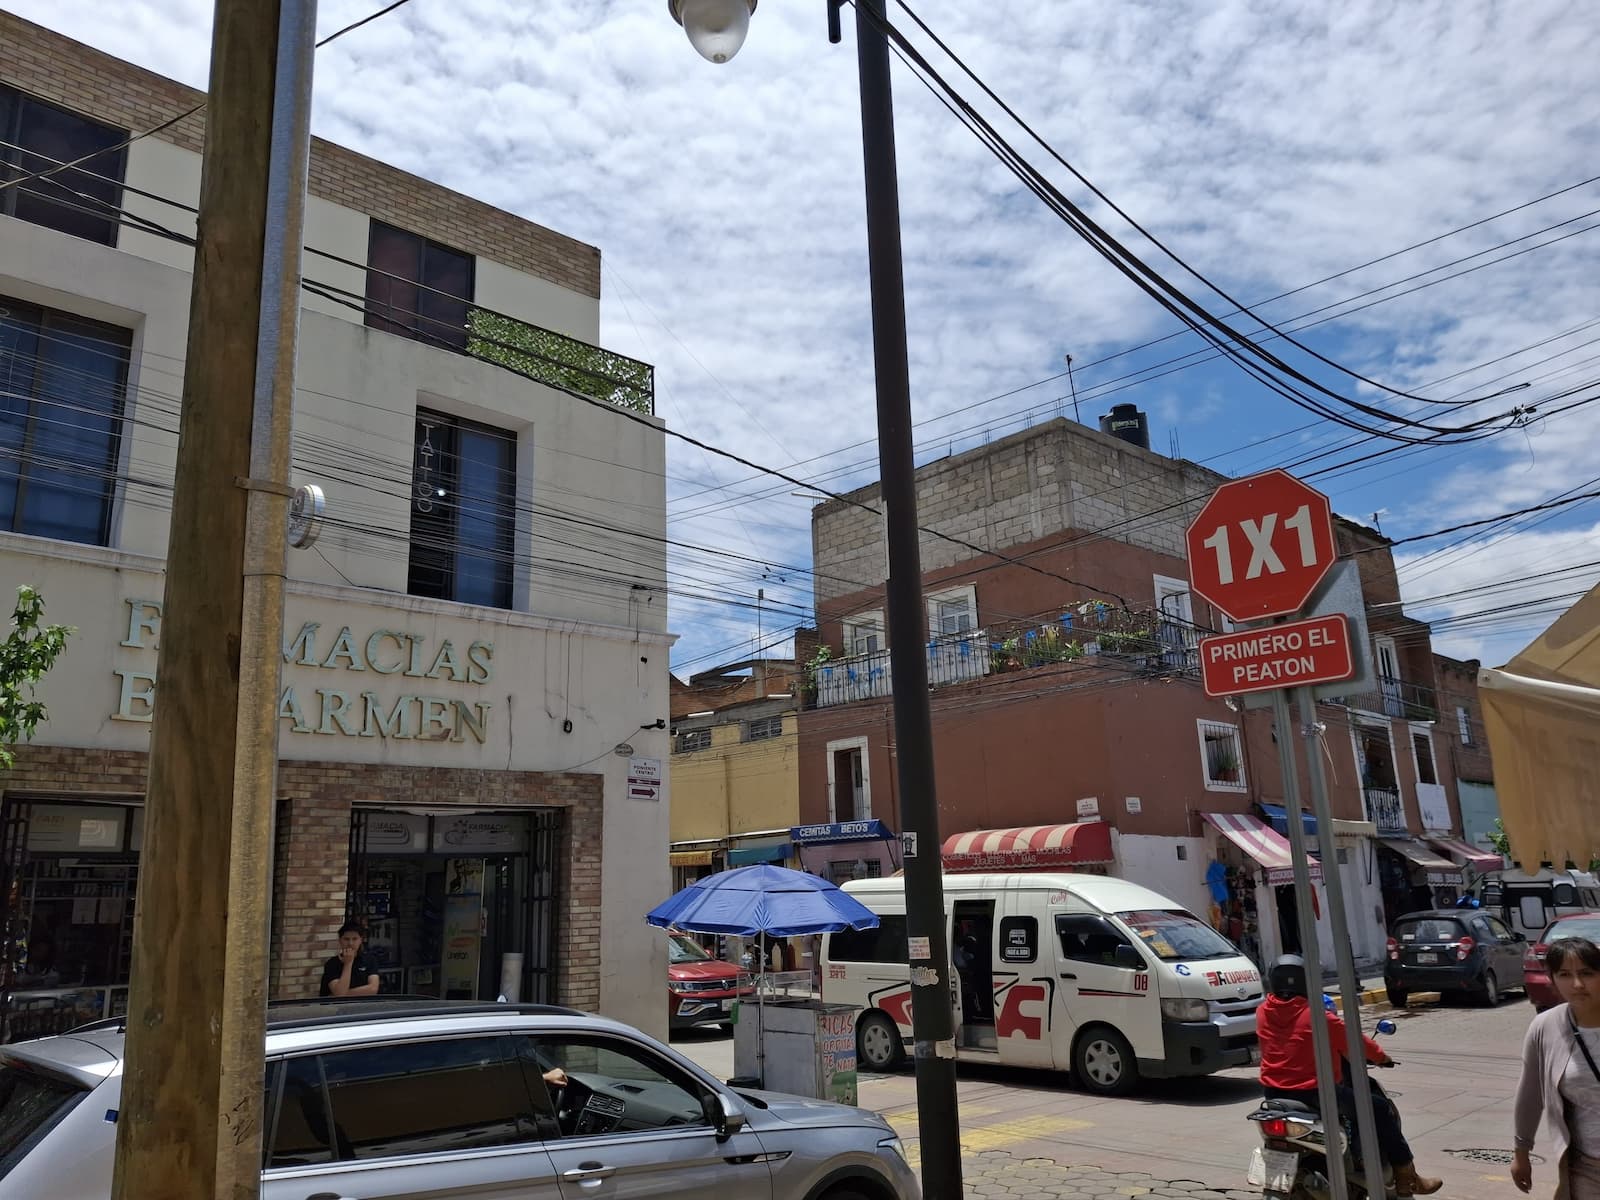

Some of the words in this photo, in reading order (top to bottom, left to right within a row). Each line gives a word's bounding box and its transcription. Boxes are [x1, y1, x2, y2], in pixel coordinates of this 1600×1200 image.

[417, 423, 435, 513] TATTOO
[1203, 504, 1318, 585] 1X1
[119, 599, 495, 685] FMACIAS
[1210, 632, 1303, 664] PRIMERO
[1308, 627, 1336, 648] EL
[1233, 655, 1316, 684] PEATON
[279, 686, 492, 745] ARMEN
[799, 826, 831, 837] CEMITAS
[840, 822, 869, 834] BETO'S
[972, 857, 1006, 866] JUGUETES
[1011, 856, 1016, 864] Y
[1035, 846, 1072, 856] MOCHILAS
[1134, 974, 1149, 991] 08
